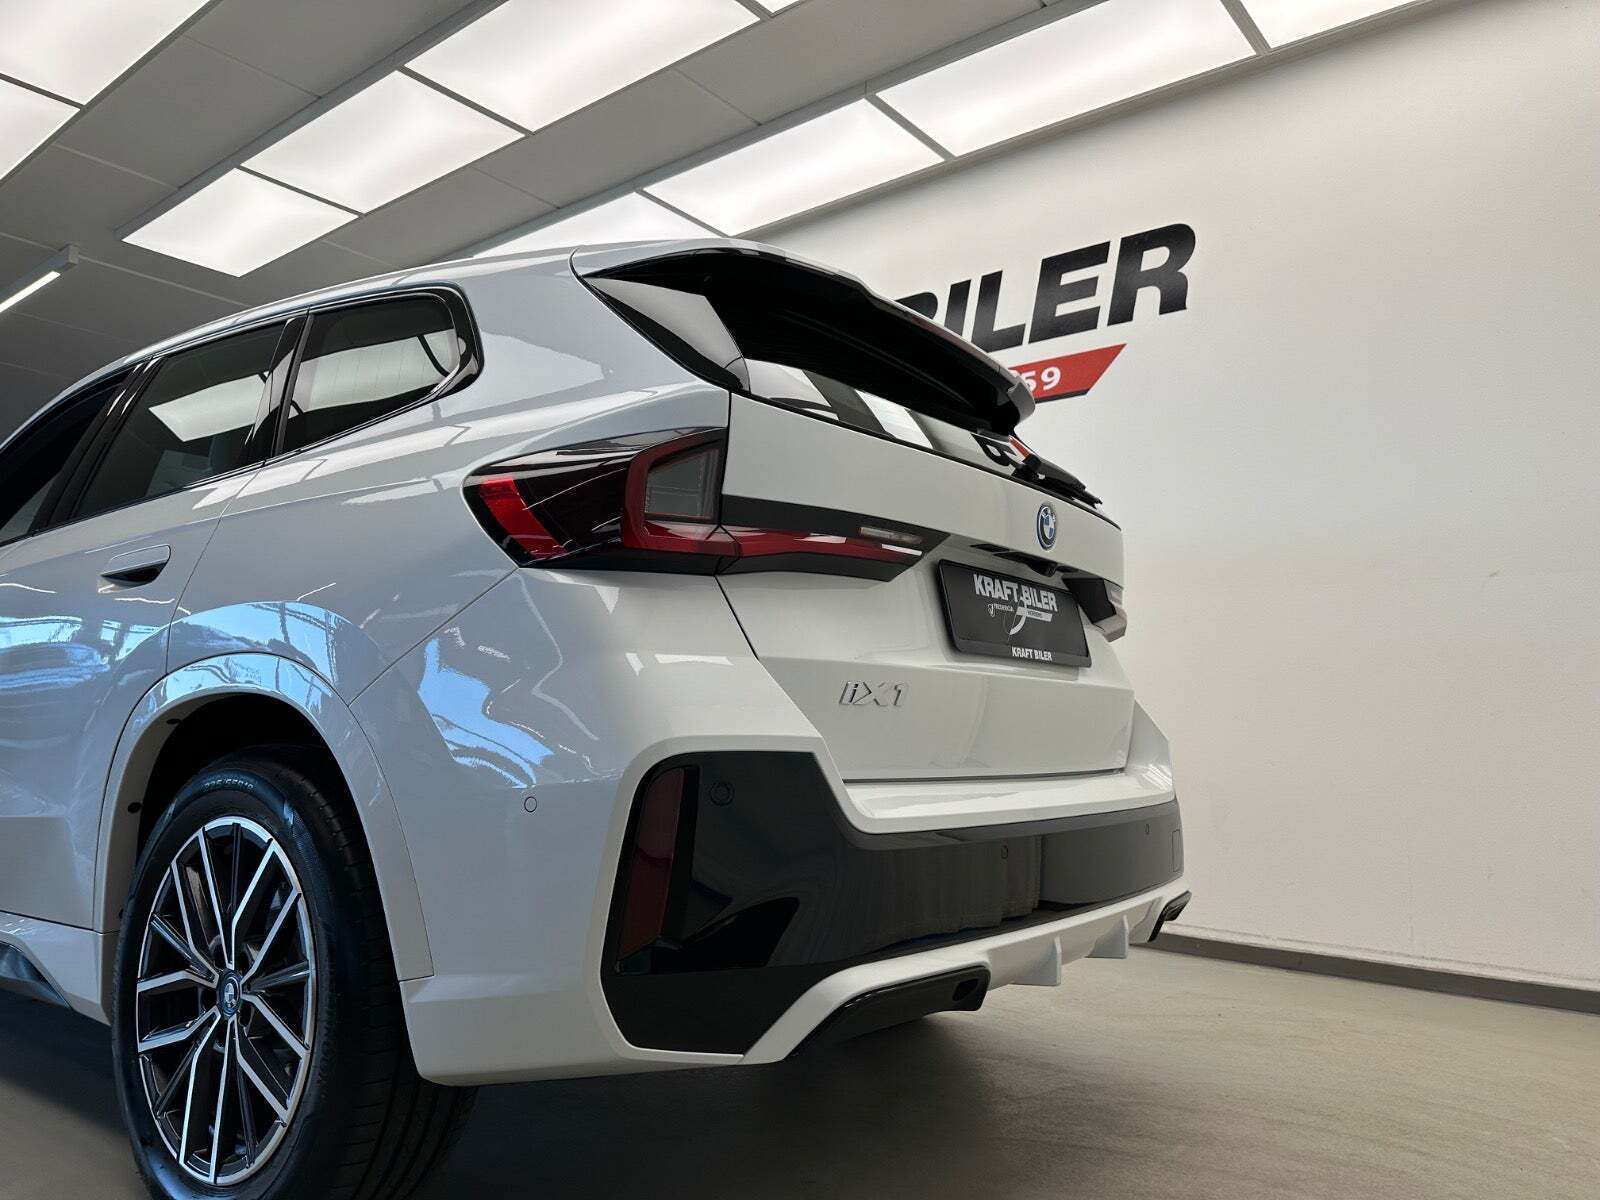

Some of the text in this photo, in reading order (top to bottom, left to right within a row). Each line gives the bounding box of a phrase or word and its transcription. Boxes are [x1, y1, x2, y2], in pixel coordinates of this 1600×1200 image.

[1008, 366, 1061, 392] 59
[973, 574, 1018, 603] KRAFT
[1020, 584, 1058, 612] BILER
[1012, 646, 1053, 662] KRAFT BILER
[839, 681, 907, 707] iX1
